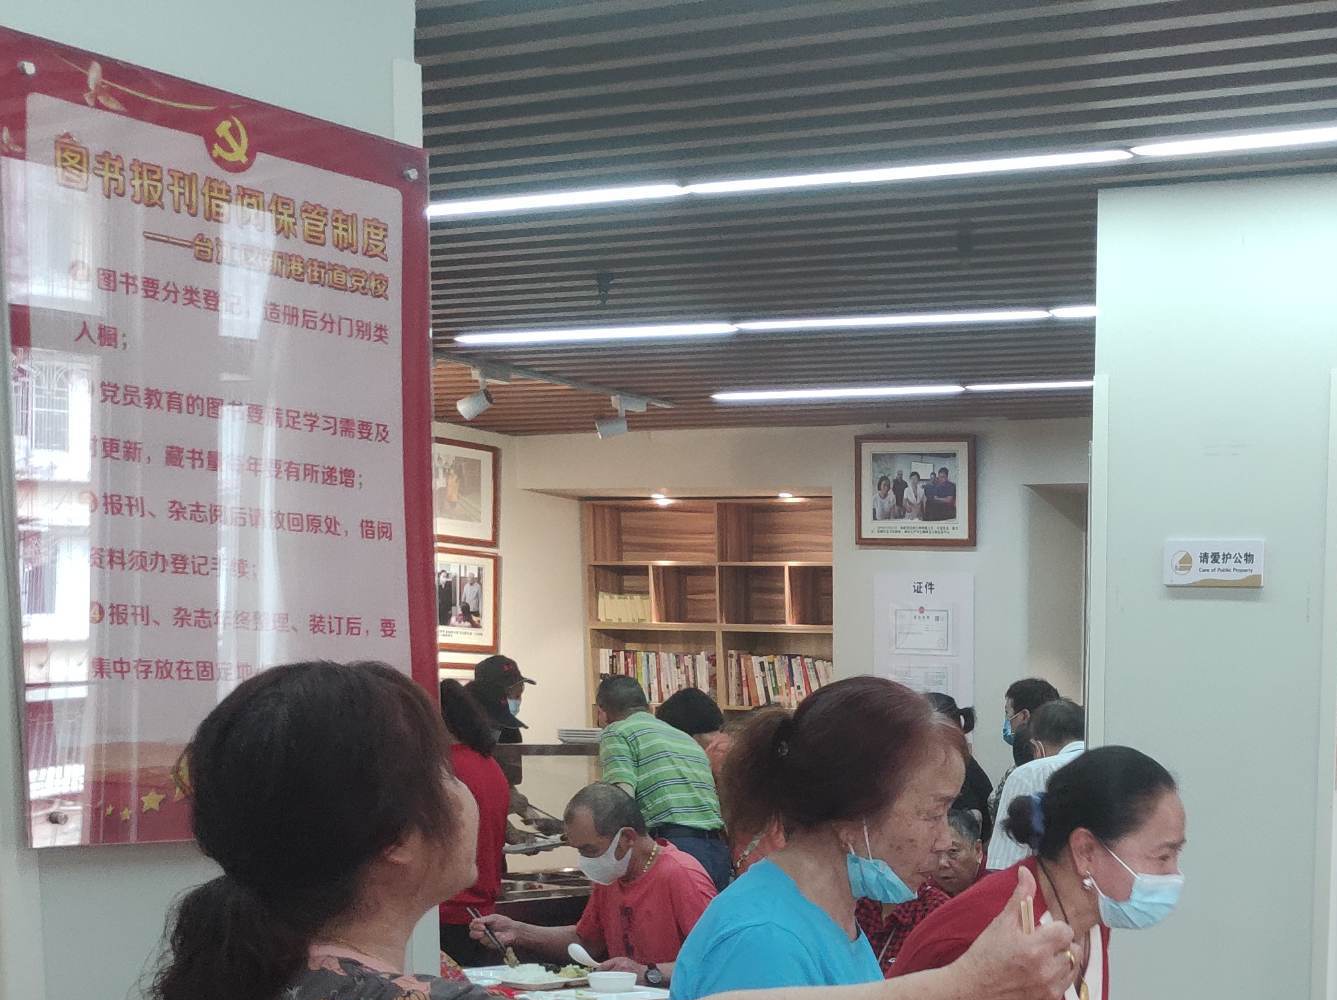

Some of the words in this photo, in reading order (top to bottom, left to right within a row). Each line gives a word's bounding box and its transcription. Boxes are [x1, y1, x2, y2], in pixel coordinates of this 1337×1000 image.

[1198, 552, 1255, 565] 请爱护公物
[912, 581, 935, 595] 证件
